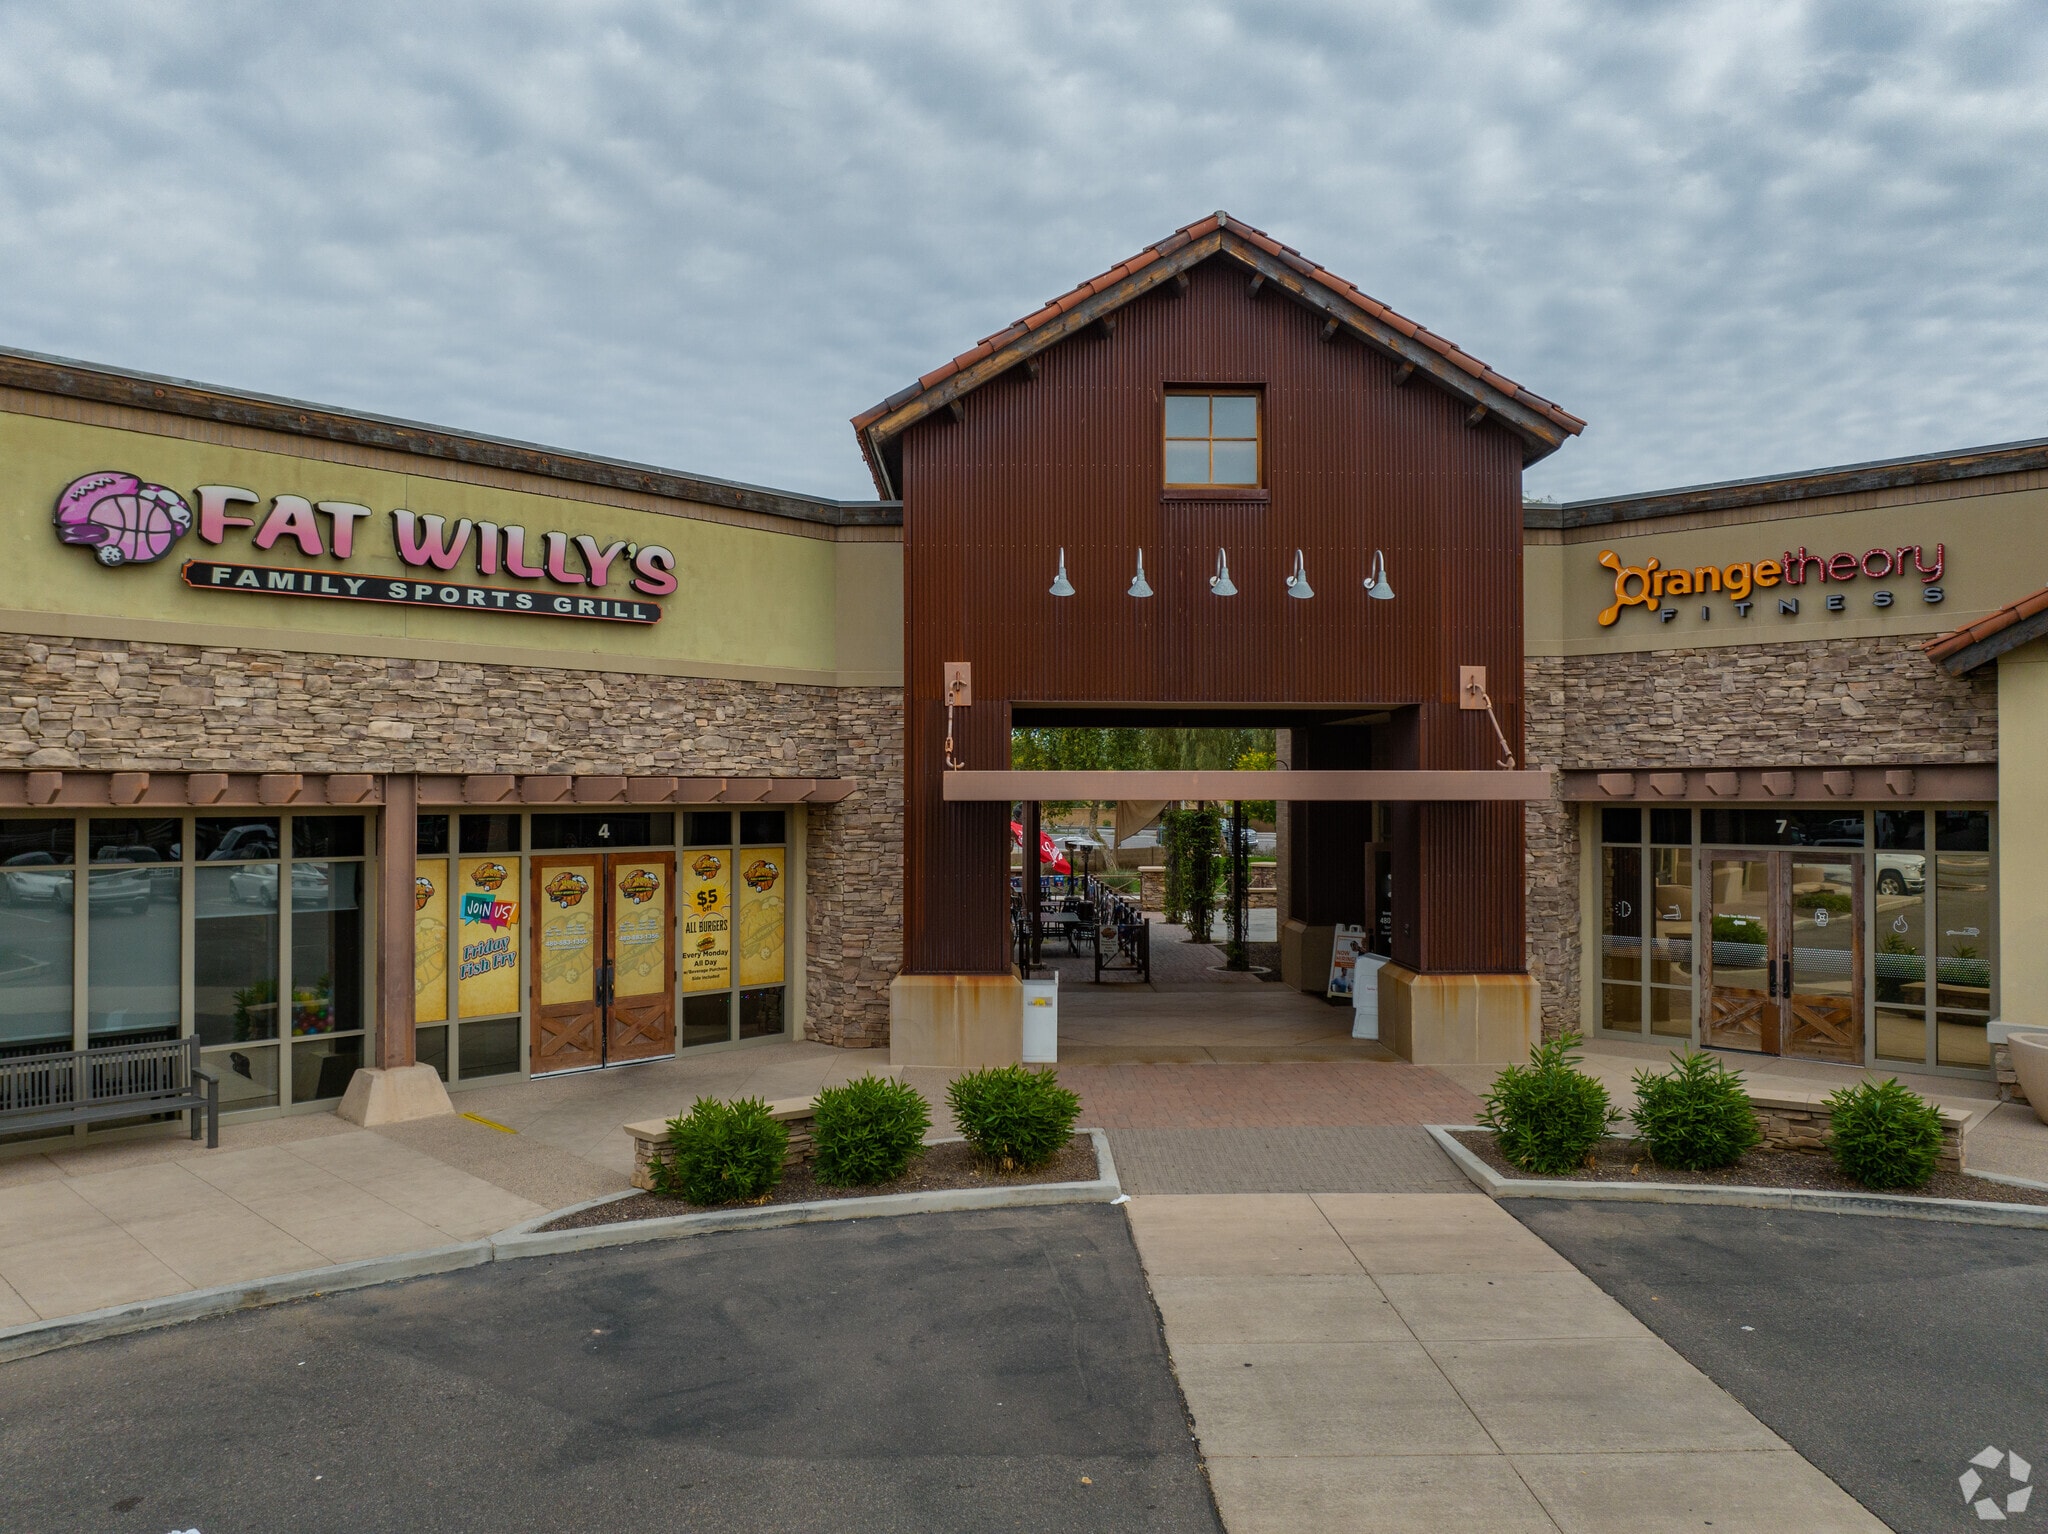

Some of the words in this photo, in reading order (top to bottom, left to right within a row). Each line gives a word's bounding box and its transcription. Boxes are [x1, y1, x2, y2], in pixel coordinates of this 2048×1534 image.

[193, 484, 373, 559] FAT
[389, 508, 678, 596] WILLY'S
[211, 566, 367, 595] FAMILY
[388, 581, 533, 609] SPORTS
[553, 596, 647, 619] GRILL
[1660, 586, 1945, 624] FITNESS
[598, 823, 610, 838] 4
[1775, 819, 1788, 834] 7
[697, 889, 718, 907] $5
[467, 900, 493, 917] JOIN
[494, 903, 517, 920] US!
[685, 921, 697, 934] ALL
[699, 919, 728, 933] BURGERS
[463, 936, 510, 961] Friday
[703, 949, 729, 957] Monday
[460, 957, 491, 980] Fish
[492, 951, 517, 970] Fry
